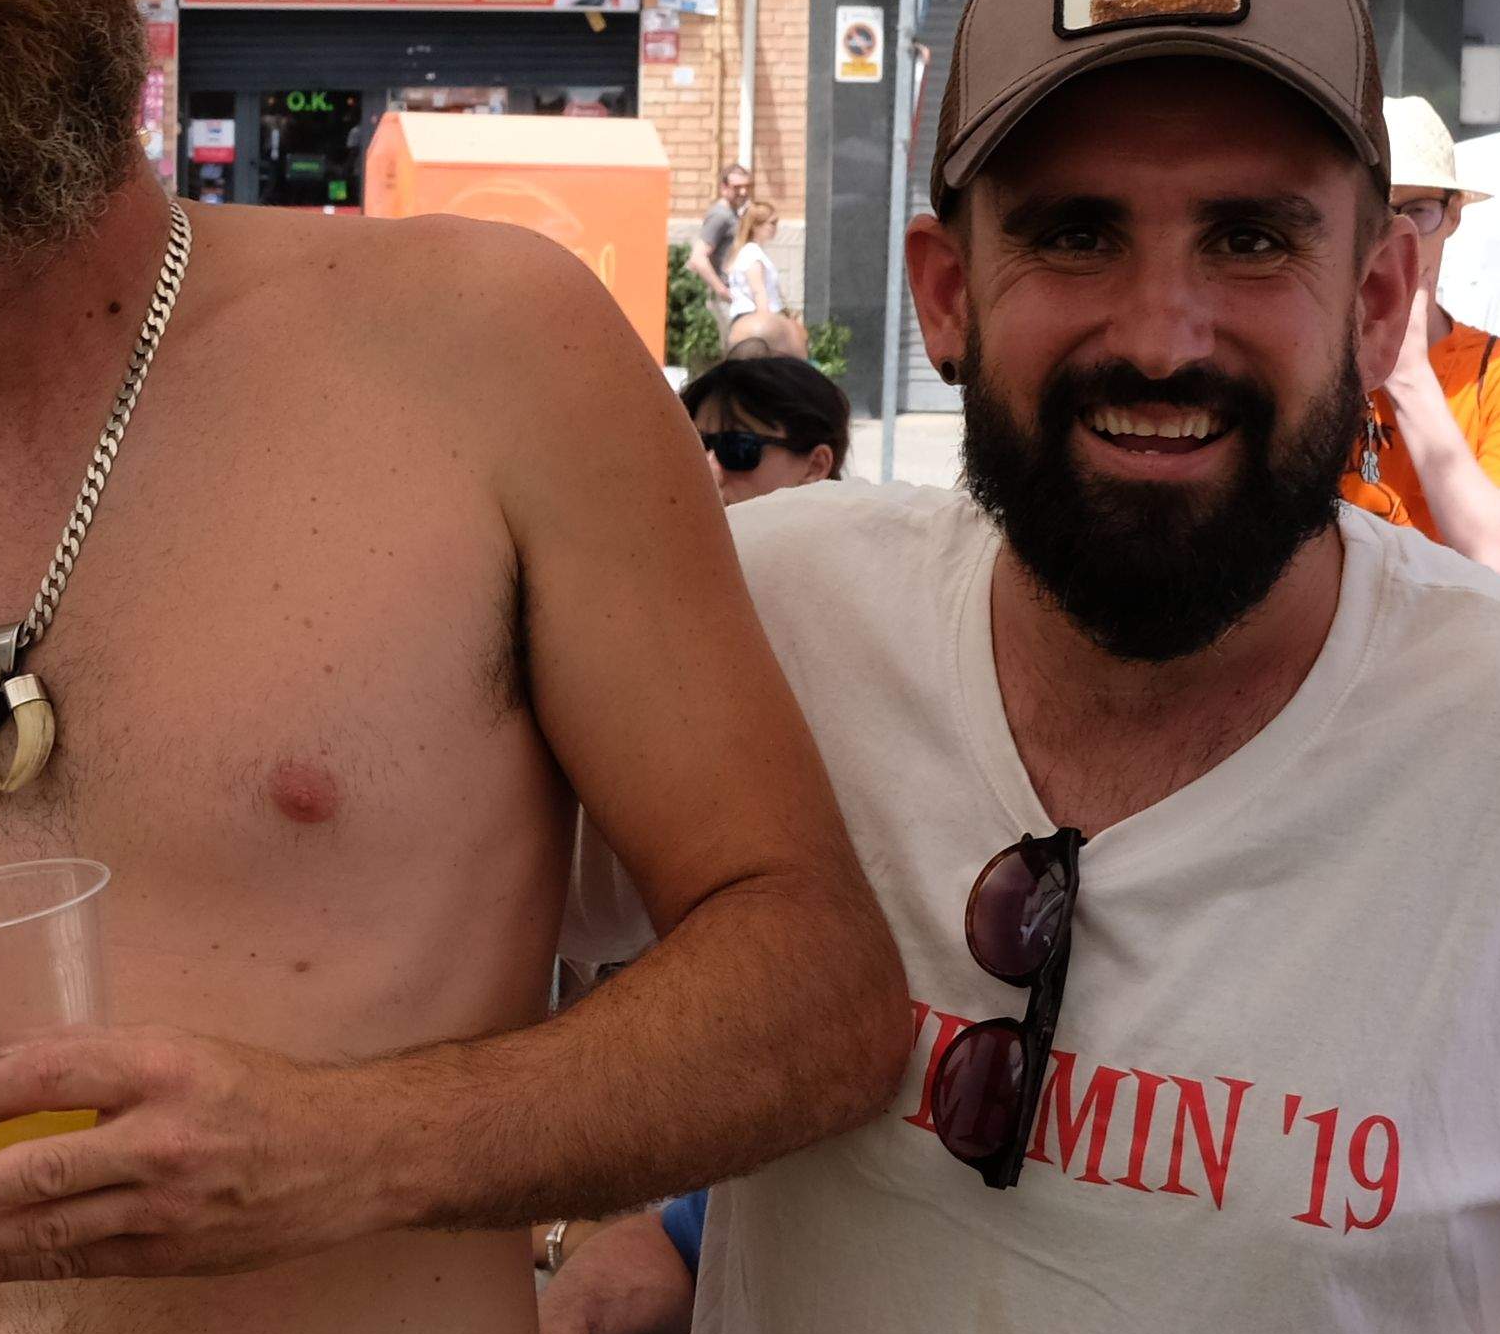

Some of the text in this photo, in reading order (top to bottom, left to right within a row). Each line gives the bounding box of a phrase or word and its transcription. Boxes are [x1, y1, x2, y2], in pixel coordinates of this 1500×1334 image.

[286, 91, 334, 112] O.K.
[902, 1001, 1401, 1235] EMIN '19
